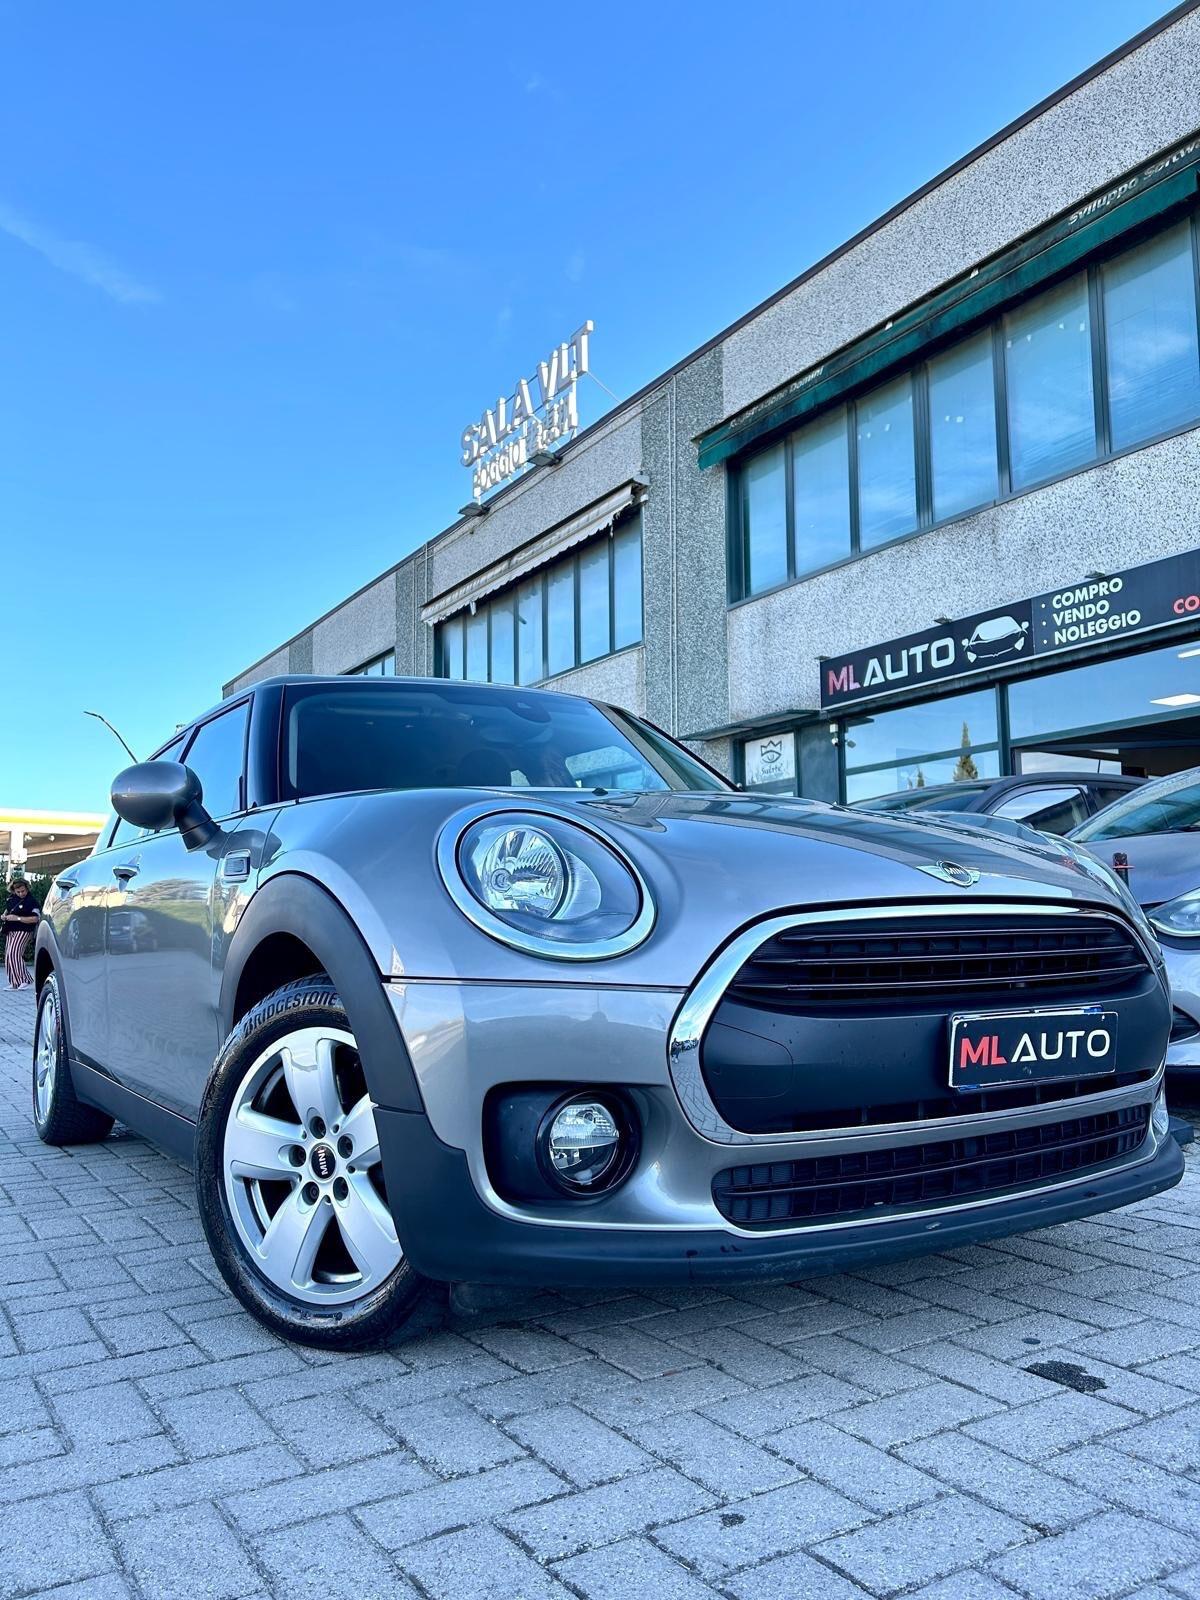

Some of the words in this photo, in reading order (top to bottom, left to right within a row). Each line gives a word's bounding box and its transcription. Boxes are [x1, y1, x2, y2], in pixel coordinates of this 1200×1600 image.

[1067, 176, 1139, 225] sviluppo
[460, 378, 534, 467] SALA
[536, 320, 594, 400] VLT
[1052, 577, 1123, 609] COMPRO
[1053, 599, 1110, 626] VENDO
[1054, 610, 1141, 645] NOLEGGIO
[828, 664, 861, 696] ML
[863, 637, 956, 687] AUTO
[243, 990, 339, 1038] BRIDGESTONE
[960, 1035, 1007, 1069] ML
[1011, 1029, 1111, 1062] AUTO
[317, 1149, 329, 1176] MINI
